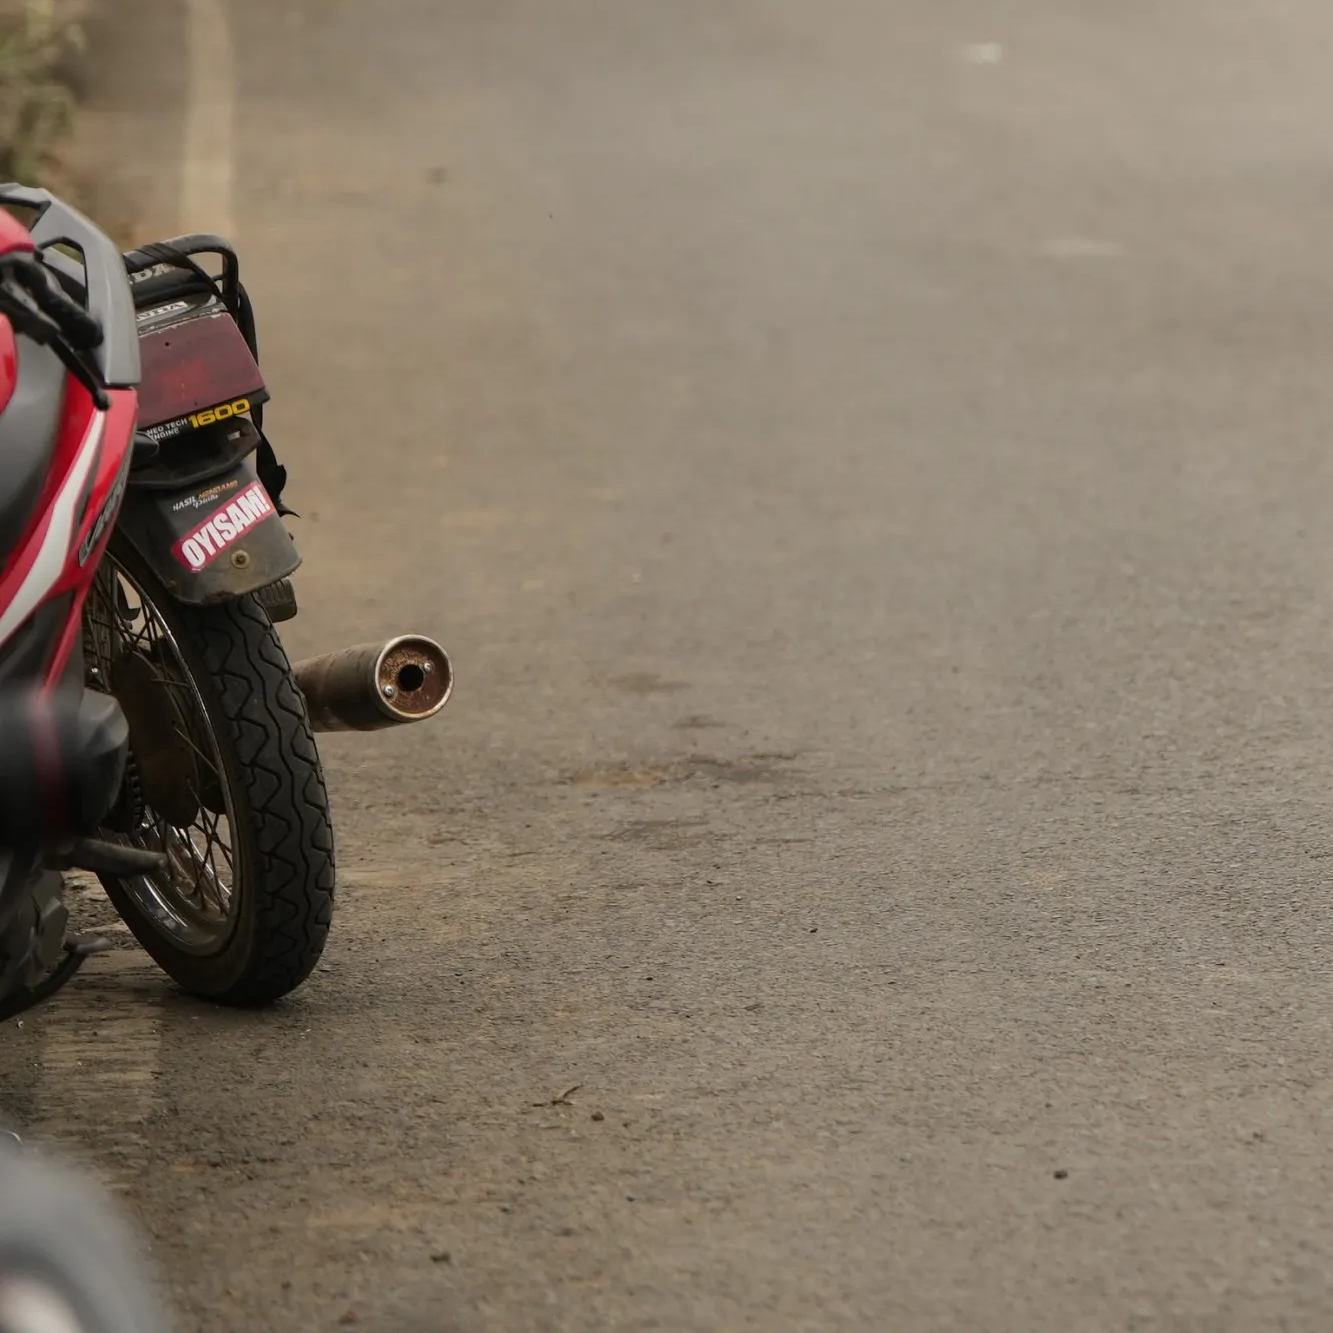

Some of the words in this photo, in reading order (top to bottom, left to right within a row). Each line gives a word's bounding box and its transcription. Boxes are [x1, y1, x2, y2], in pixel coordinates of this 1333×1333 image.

[188, 398, 251, 429] 1600
[146, 423, 164, 435] NEO
[165, 418, 188, 430] TECH
[172, 495, 195, 512] HASIL
[181, 485, 271, 568] OYISAM!
